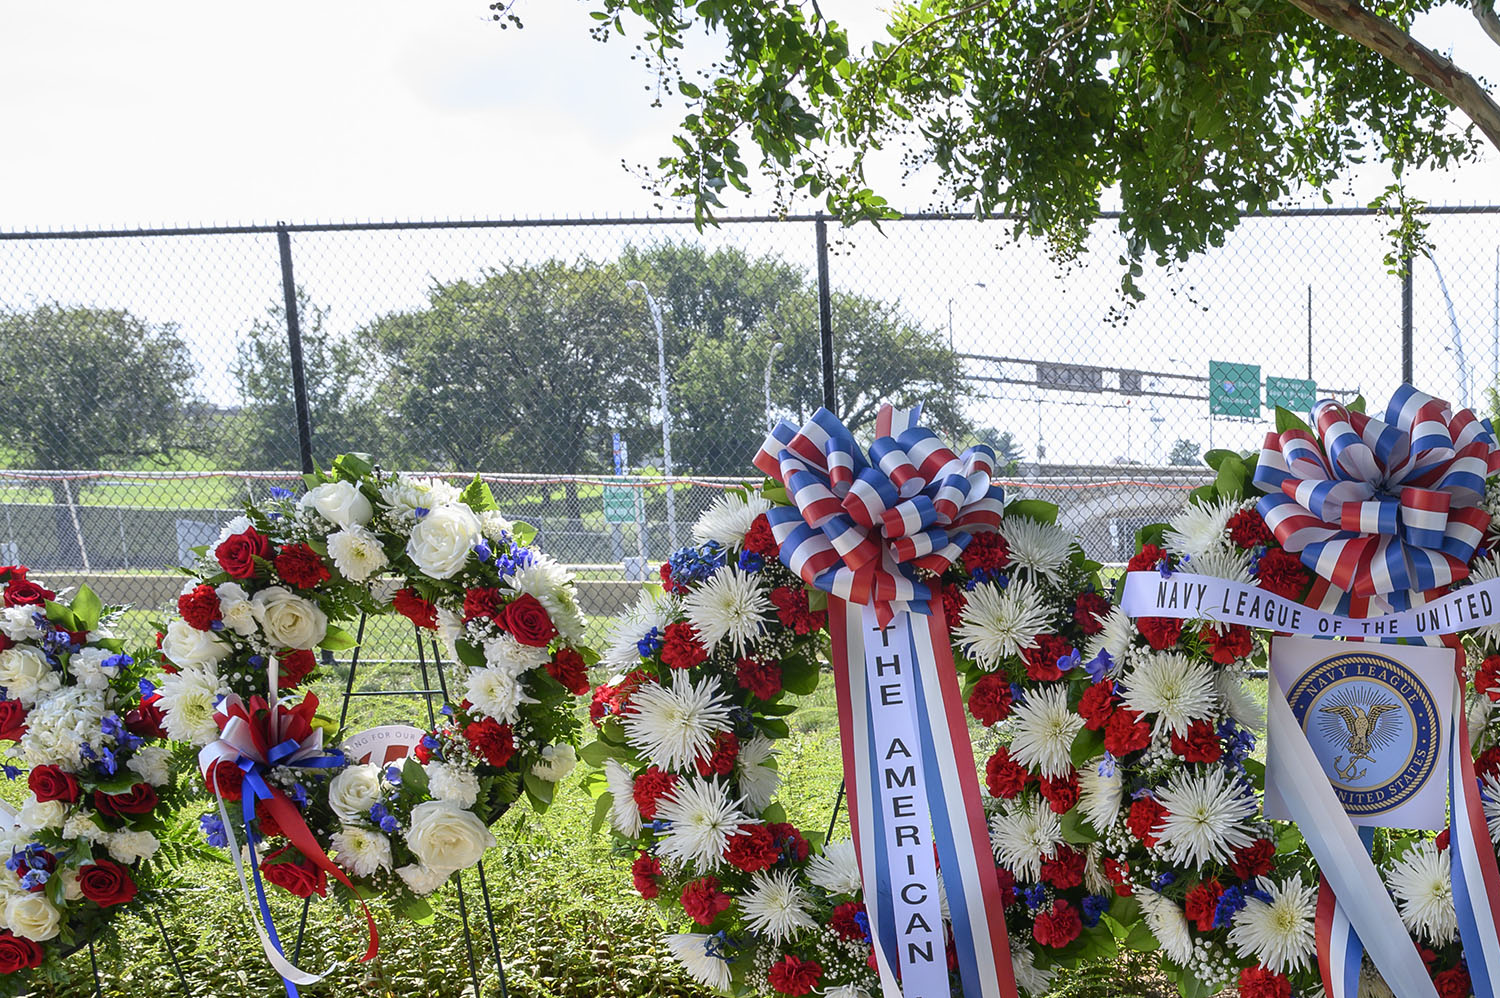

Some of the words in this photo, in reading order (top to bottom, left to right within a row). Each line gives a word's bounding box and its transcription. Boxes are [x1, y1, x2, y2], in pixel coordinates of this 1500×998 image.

[1156, 581, 1208, 614] NAVY
[1222, 588, 1301, 630] LEAGUE
[1318, 618, 1343, 633] OF
[1361, 619, 1398, 634] THE
[1416, 590, 1493, 633] UNITED
[872, 625, 904, 706] THE
[1306, 665, 1349, 698] NAVY
[1357, 664, 1419, 705] LEAGUE
[371, 731, 391, 741] FOR
[1335, 789, 1385, 804] NITED
[1388, 749, 1427, 796] STATES
[885, 737, 934, 964] AMERICAN
